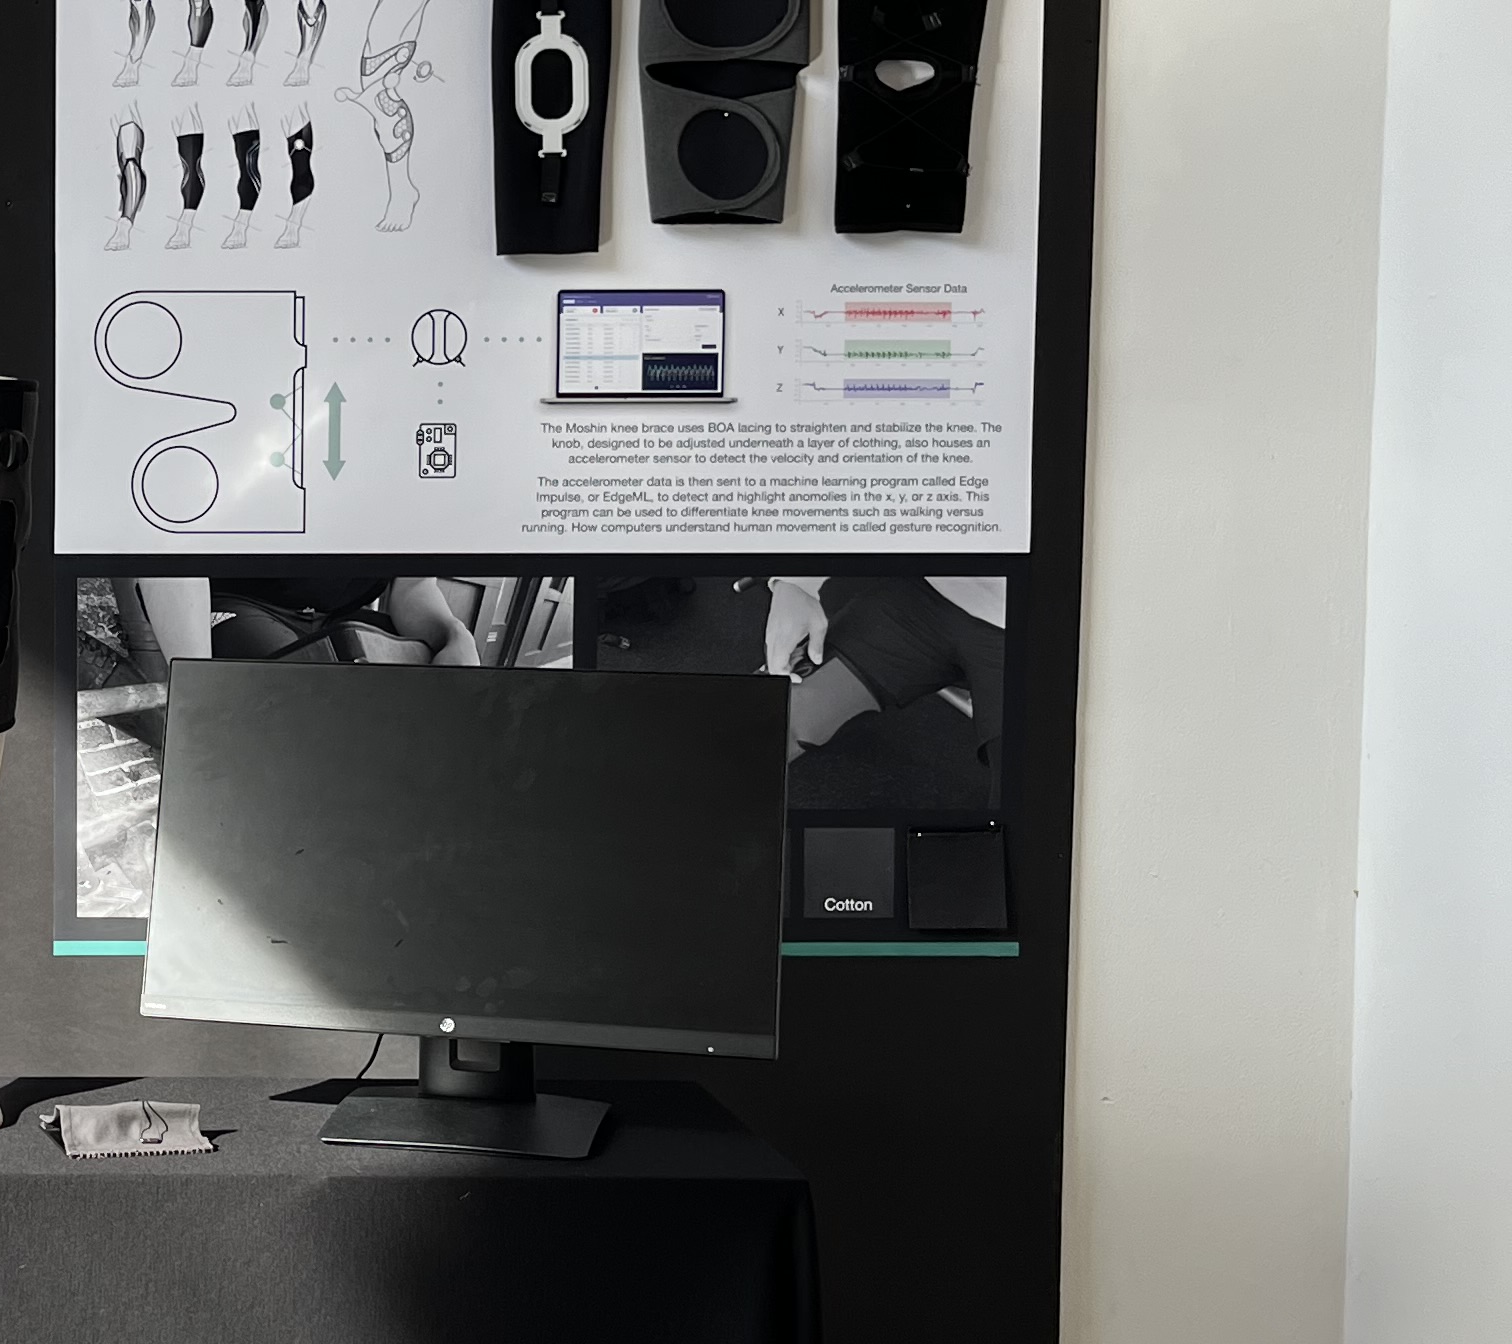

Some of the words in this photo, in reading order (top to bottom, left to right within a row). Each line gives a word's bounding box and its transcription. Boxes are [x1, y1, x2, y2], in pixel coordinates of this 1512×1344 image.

[830, 283, 903, 293] Accelerometer
[905, 283, 941, 293] Sensor
[943, 283, 967, 293] Data
[778, 308, 785, 316] X
[777, 346, 784, 354] Y
[776, 383, 783, 392] Z
[540, 422, 562, 433] The
[565, 422, 607, 433] Moshin
[610, 423, 638, 433] knee
[641, 422, 674, 433] brace
[677, 424, 704, 433] uses
[707, 421, 734, 433] BOA
[737, 422, 771, 435] lacing
[775, 423, 786, 432] to
[789, 422, 846, 435] straighten
[850, 422, 872, 432] and
[875, 422, 921, 432] stabilize
[924, 422, 943, 432] the
[946, 422, 977, 432] knee.
[980, 421, 1002, 432] The
[521, 523, 566, 535] running.
[571, 521, 597, 532] How
[600, 522, 662, 534] computers
[665, 522, 730, 532] understand
[733, 521, 772, 532] human
[775, 522, 836, 532] movement
[839, 522, 849, 532] is
[852, 521, 886, 532] called
[889, 522, 932, 534] gesture
[935, 521, 1002, 534] recognition.
[824, 897, 872, 911] Cotton
